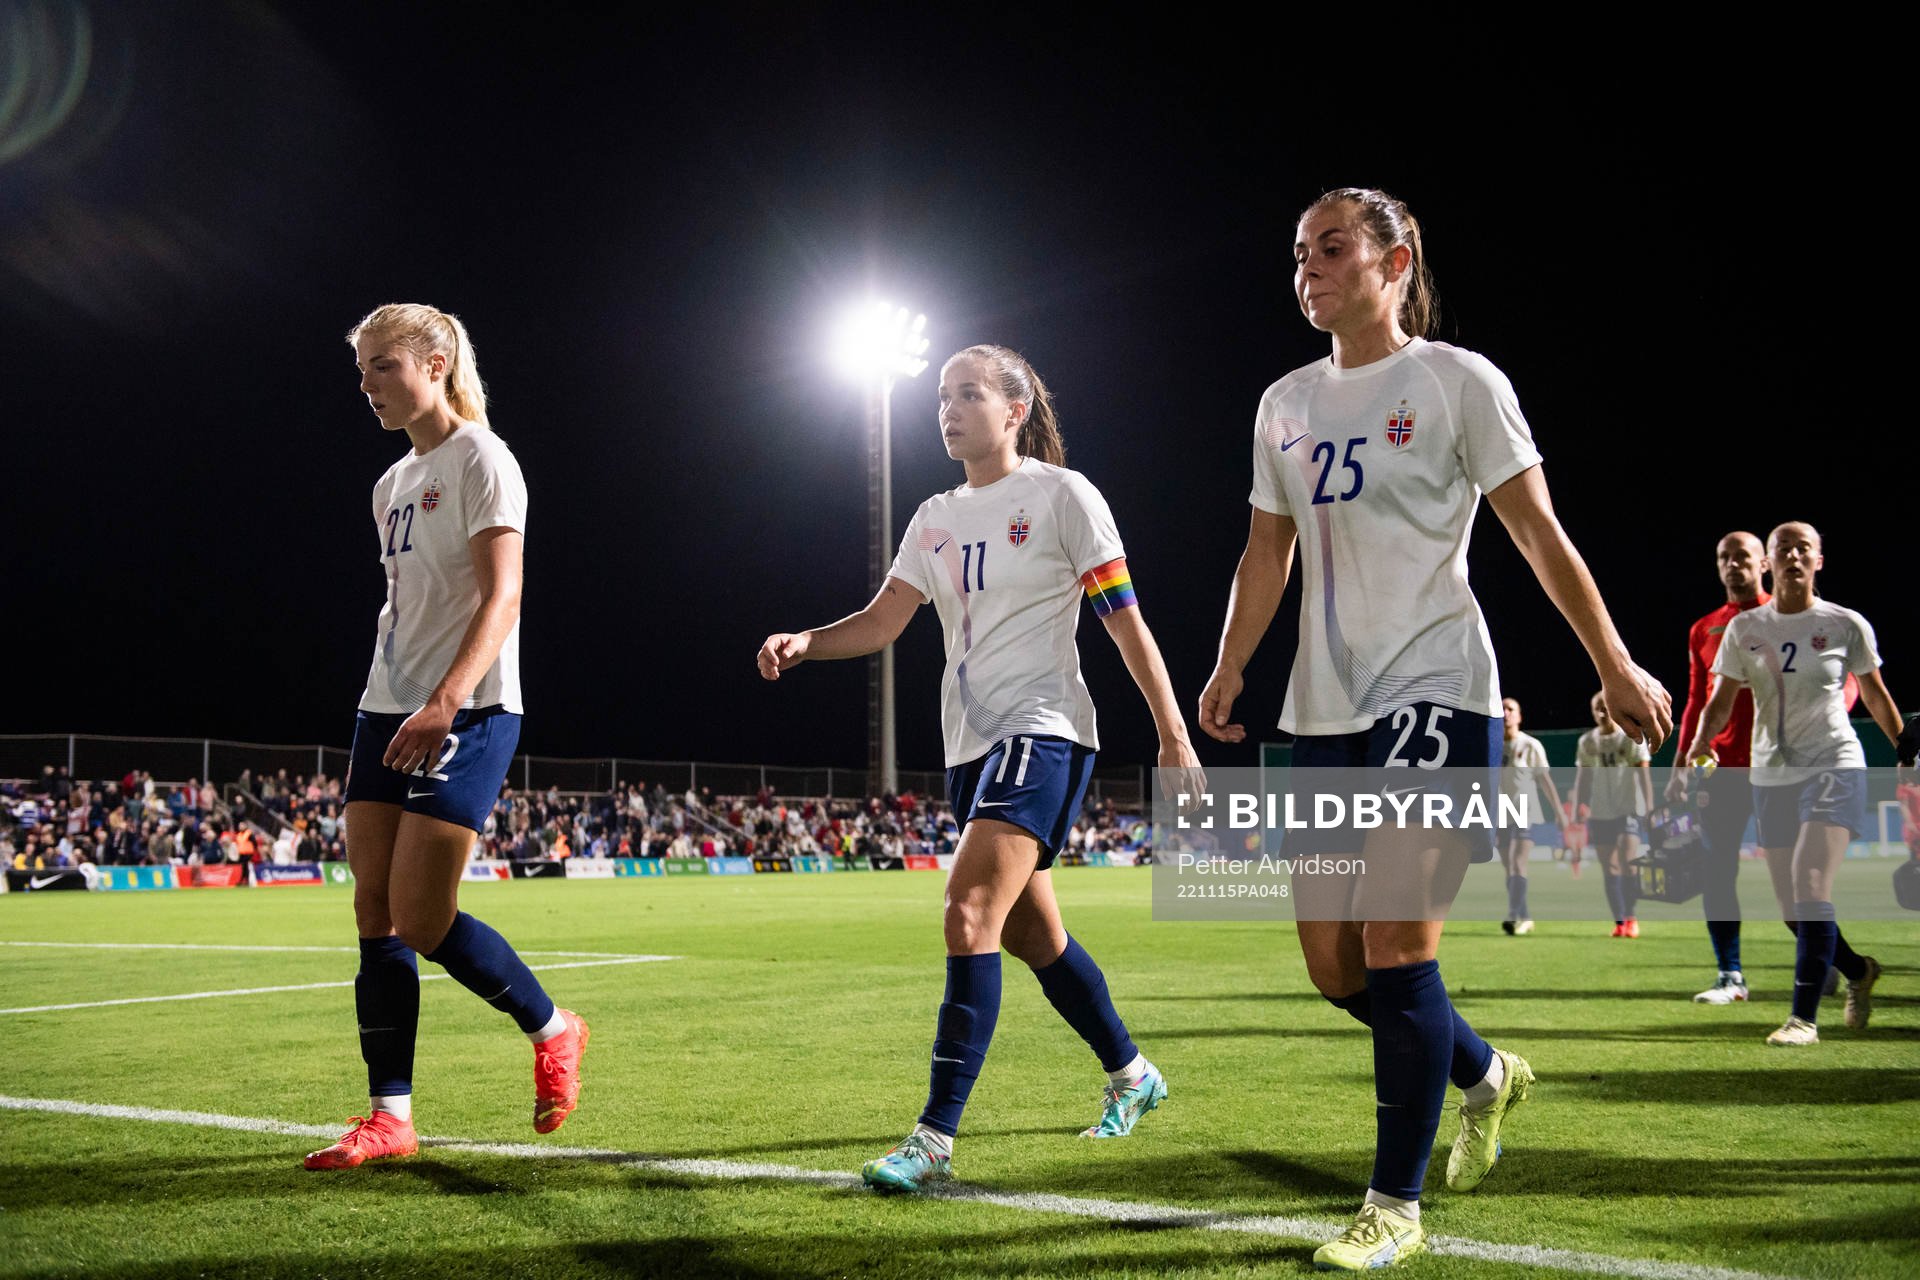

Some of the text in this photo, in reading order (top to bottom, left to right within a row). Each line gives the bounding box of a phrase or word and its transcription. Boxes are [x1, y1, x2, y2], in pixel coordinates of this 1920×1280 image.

[1311, 437, 1367, 505] 25
[386, 503, 414, 557] 22
[962, 540, 987, 593] 11
[1781, 642, 1797, 673] 2
[411, 733, 460, 782] 2
[995, 736, 1033, 786] 11
[1384, 706, 1453, 771] 25
[1818, 772, 1835, 802] 2
